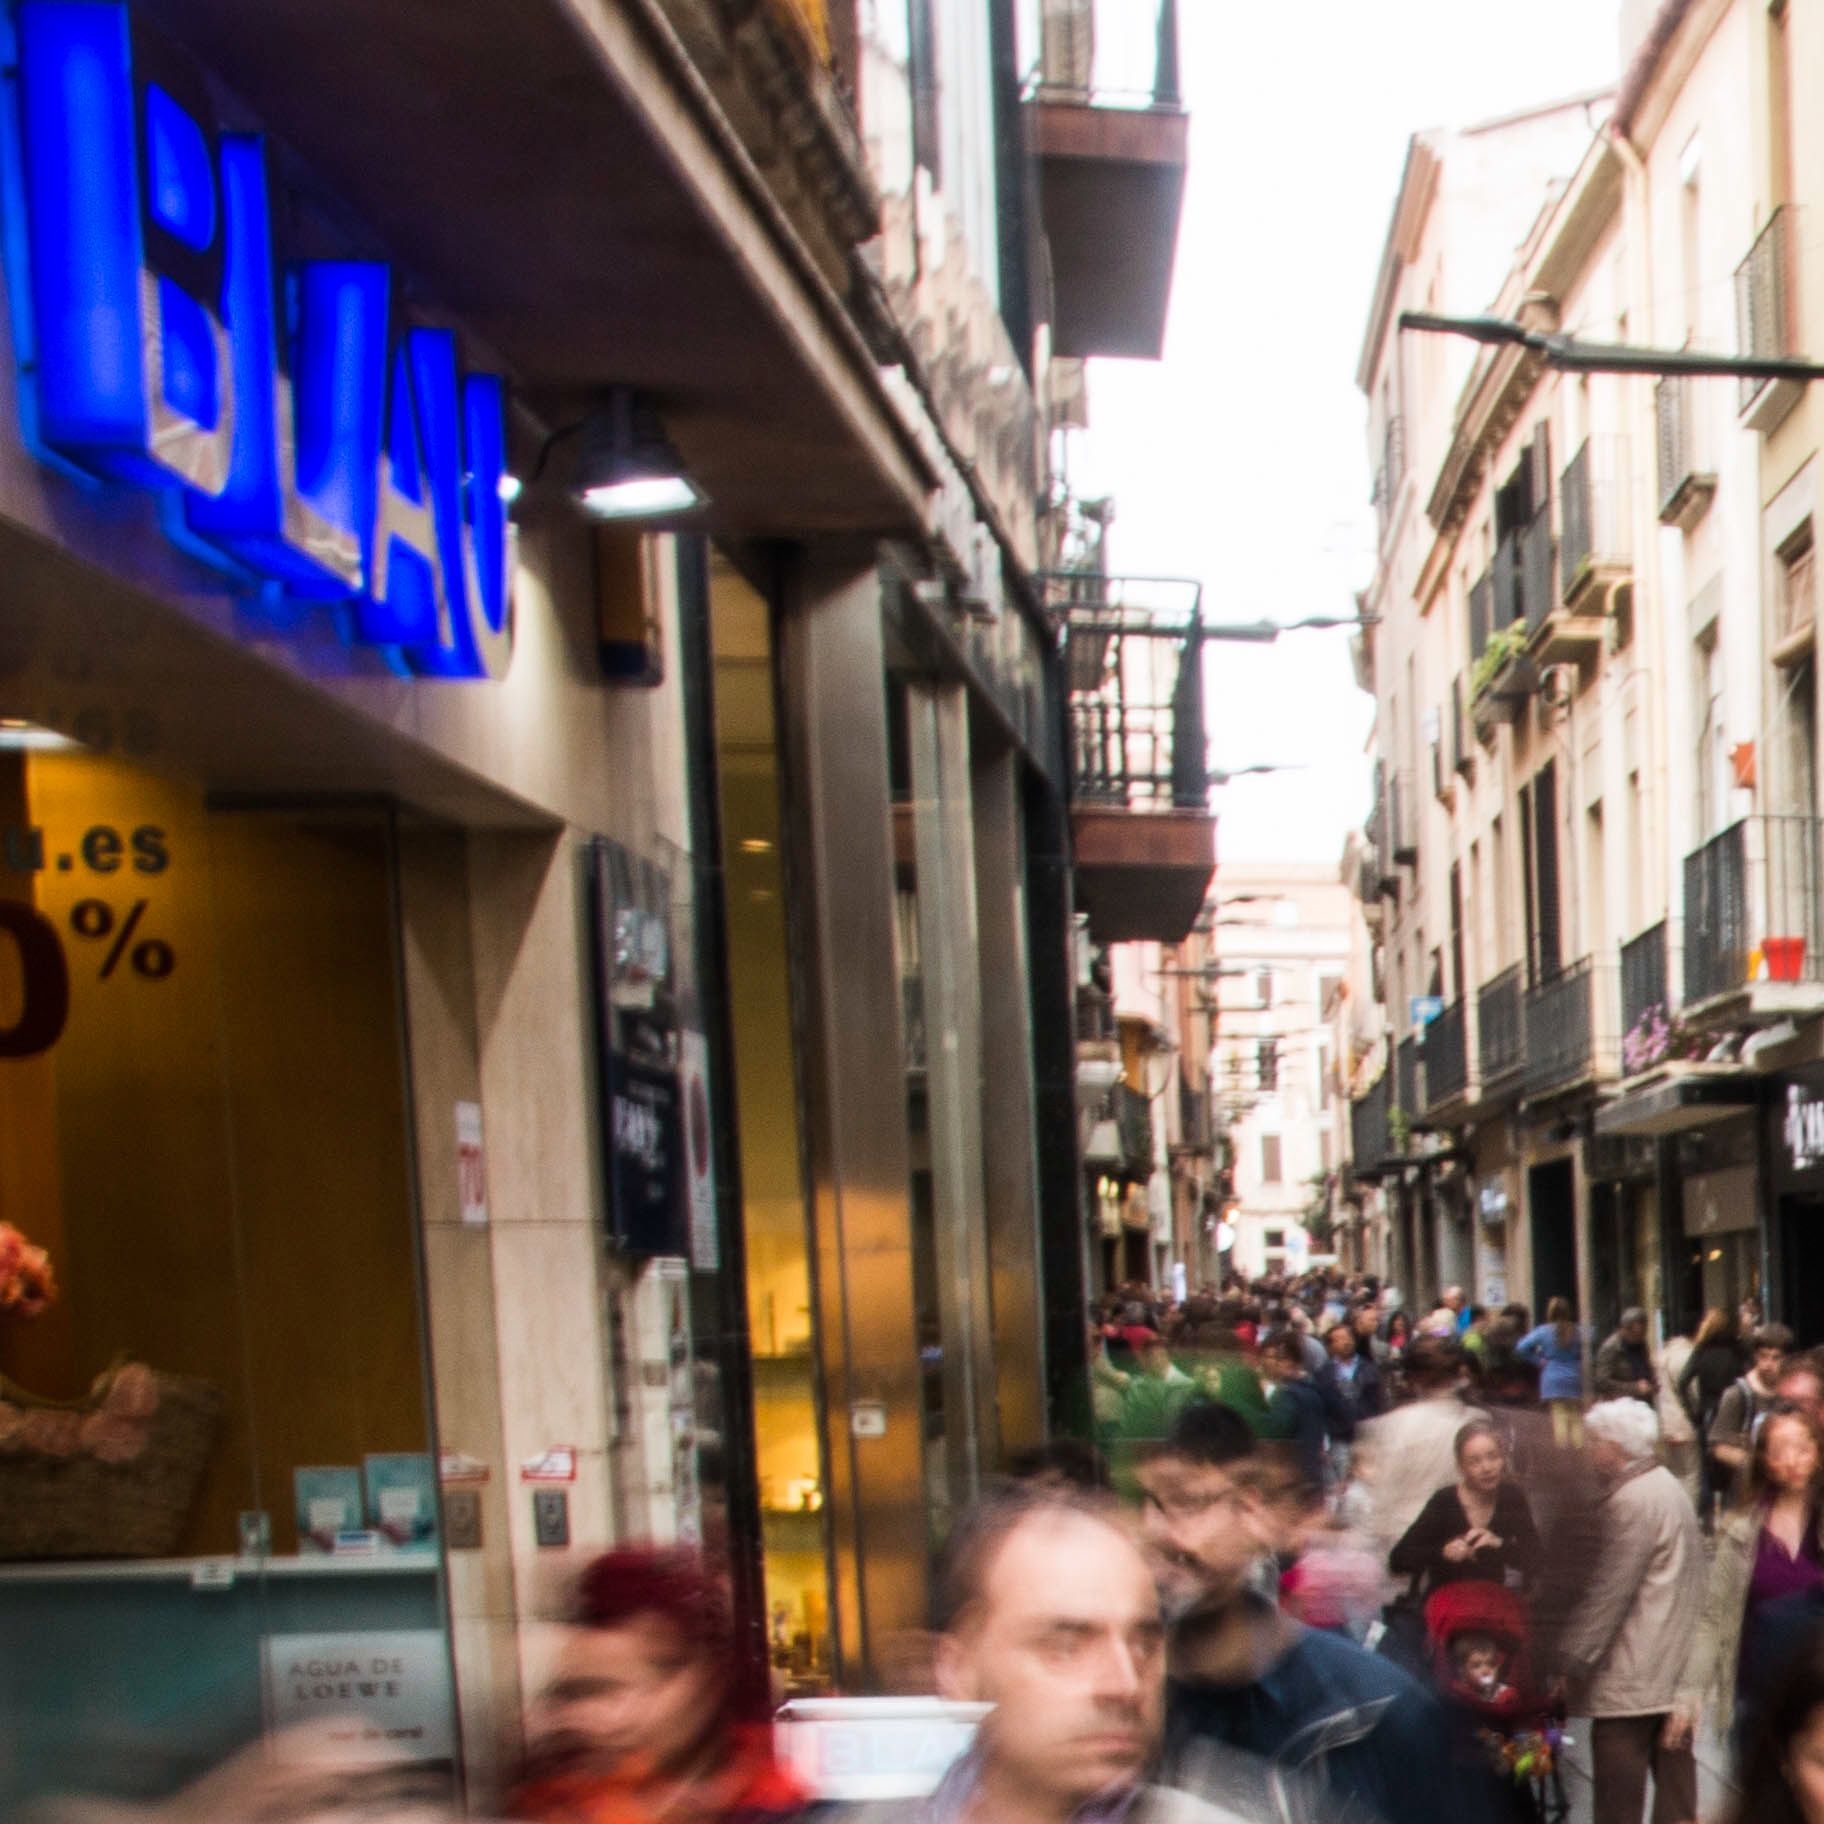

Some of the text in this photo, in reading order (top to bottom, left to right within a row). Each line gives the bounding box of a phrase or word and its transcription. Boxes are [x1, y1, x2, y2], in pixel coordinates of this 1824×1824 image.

[290, 1657, 405, 1677] AGUA DE
[296, 1680, 400, 1699] LOEWE
